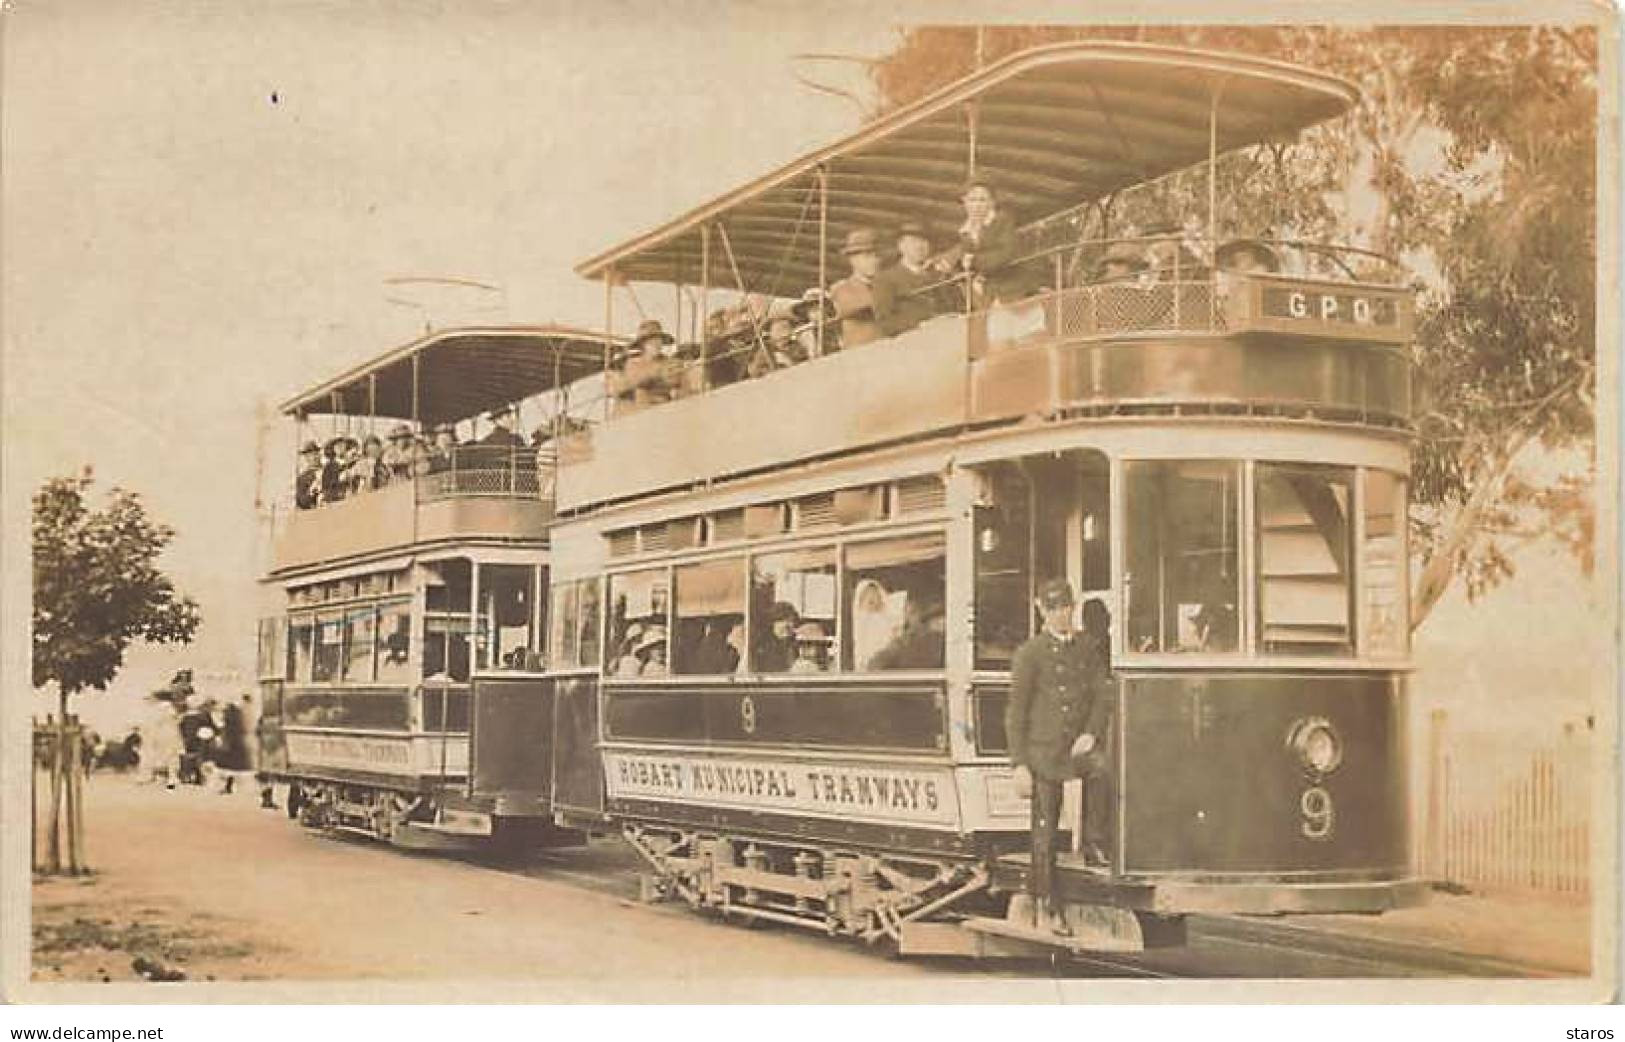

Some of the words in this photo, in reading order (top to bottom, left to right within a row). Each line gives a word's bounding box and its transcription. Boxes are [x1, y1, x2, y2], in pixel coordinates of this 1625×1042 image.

[741, 695, 755, 733] 9
[619, 759, 684, 790] HOBART
[691, 763, 797, 798] MUNICIPAL
[807, 772, 939, 811] TRAMWAYS
[1302, 787, 1331, 838] 9
